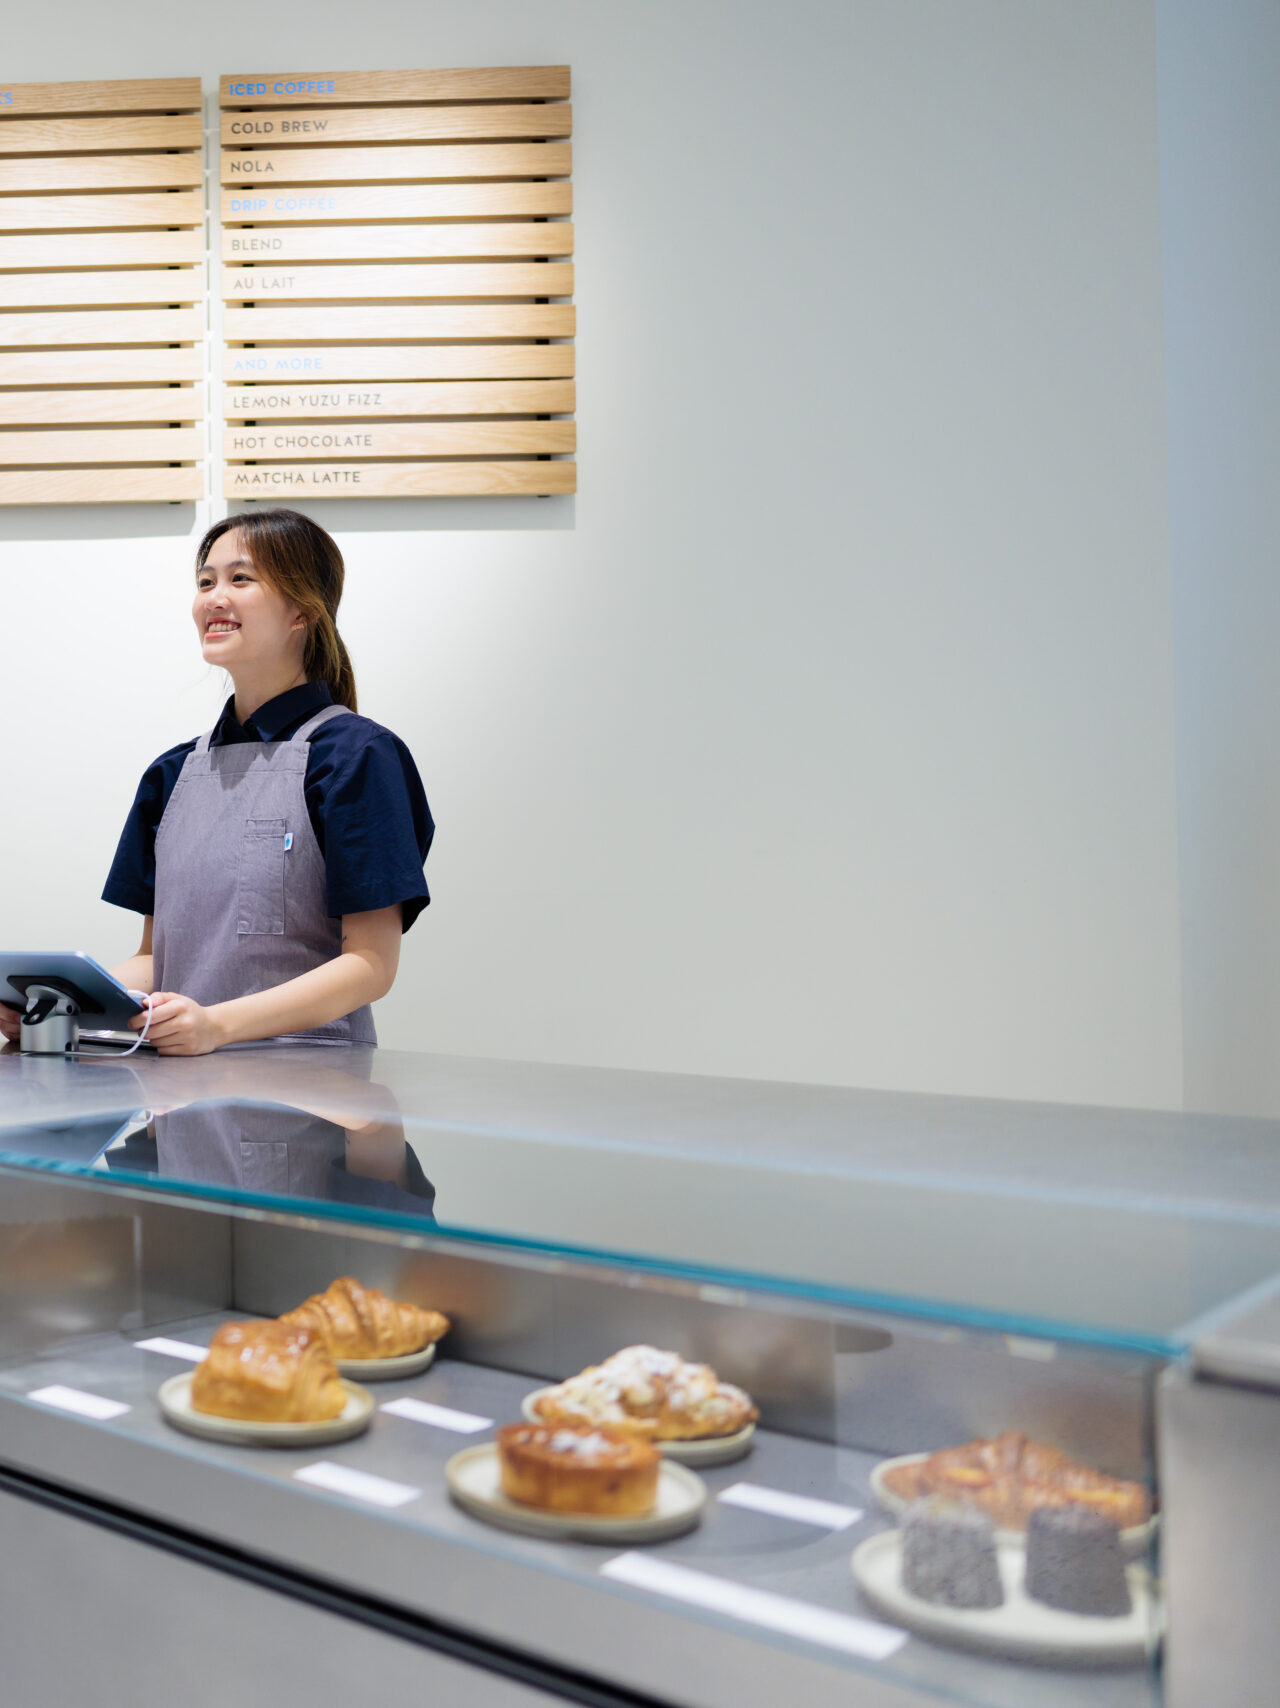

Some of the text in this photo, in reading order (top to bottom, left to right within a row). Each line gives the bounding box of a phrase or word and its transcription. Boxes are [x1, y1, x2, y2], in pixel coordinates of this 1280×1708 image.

[229, 80, 336, 96] ICED COFFEE
[231, 120, 328, 134] COLD BREW
[231, 160, 274, 173] NOLA
[231, 197, 337, 212] DRIP COFFEE
[231, 238, 282, 251] BLEND
[233, 276, 296, 290] AU LAIT
[233, 357, 323, 371] AND MORE
[233, 394, 382, 408] LEMON YUZU FIZZ
[233, 434, 372, 449] HOT CHOCOLATE
[234, 471, 361, 484] MATCHA LATTE
